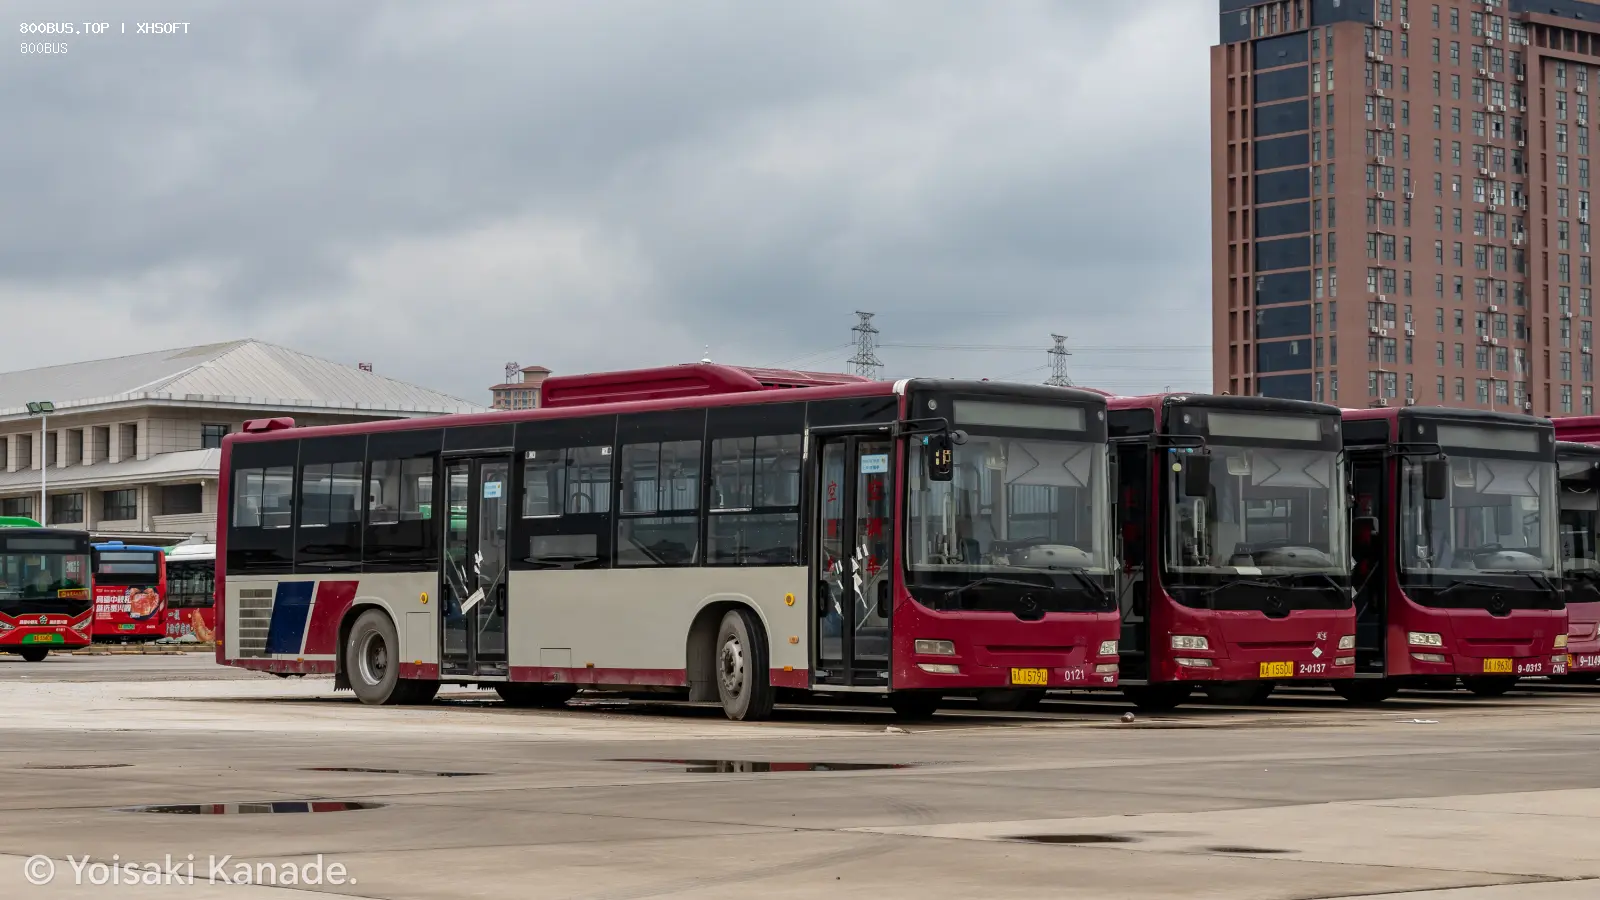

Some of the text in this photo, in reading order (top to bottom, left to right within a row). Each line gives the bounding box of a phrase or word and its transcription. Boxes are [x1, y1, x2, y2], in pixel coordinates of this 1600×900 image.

[1299, 663, 1326, 674] 2-0137
[1517, 663, 1542, 673] 9-0313
[1552, 664, 1565, 674] CNG
[1064, 669, 1085, 681] 0121
[1103, 675, 1114, 683] CNG
